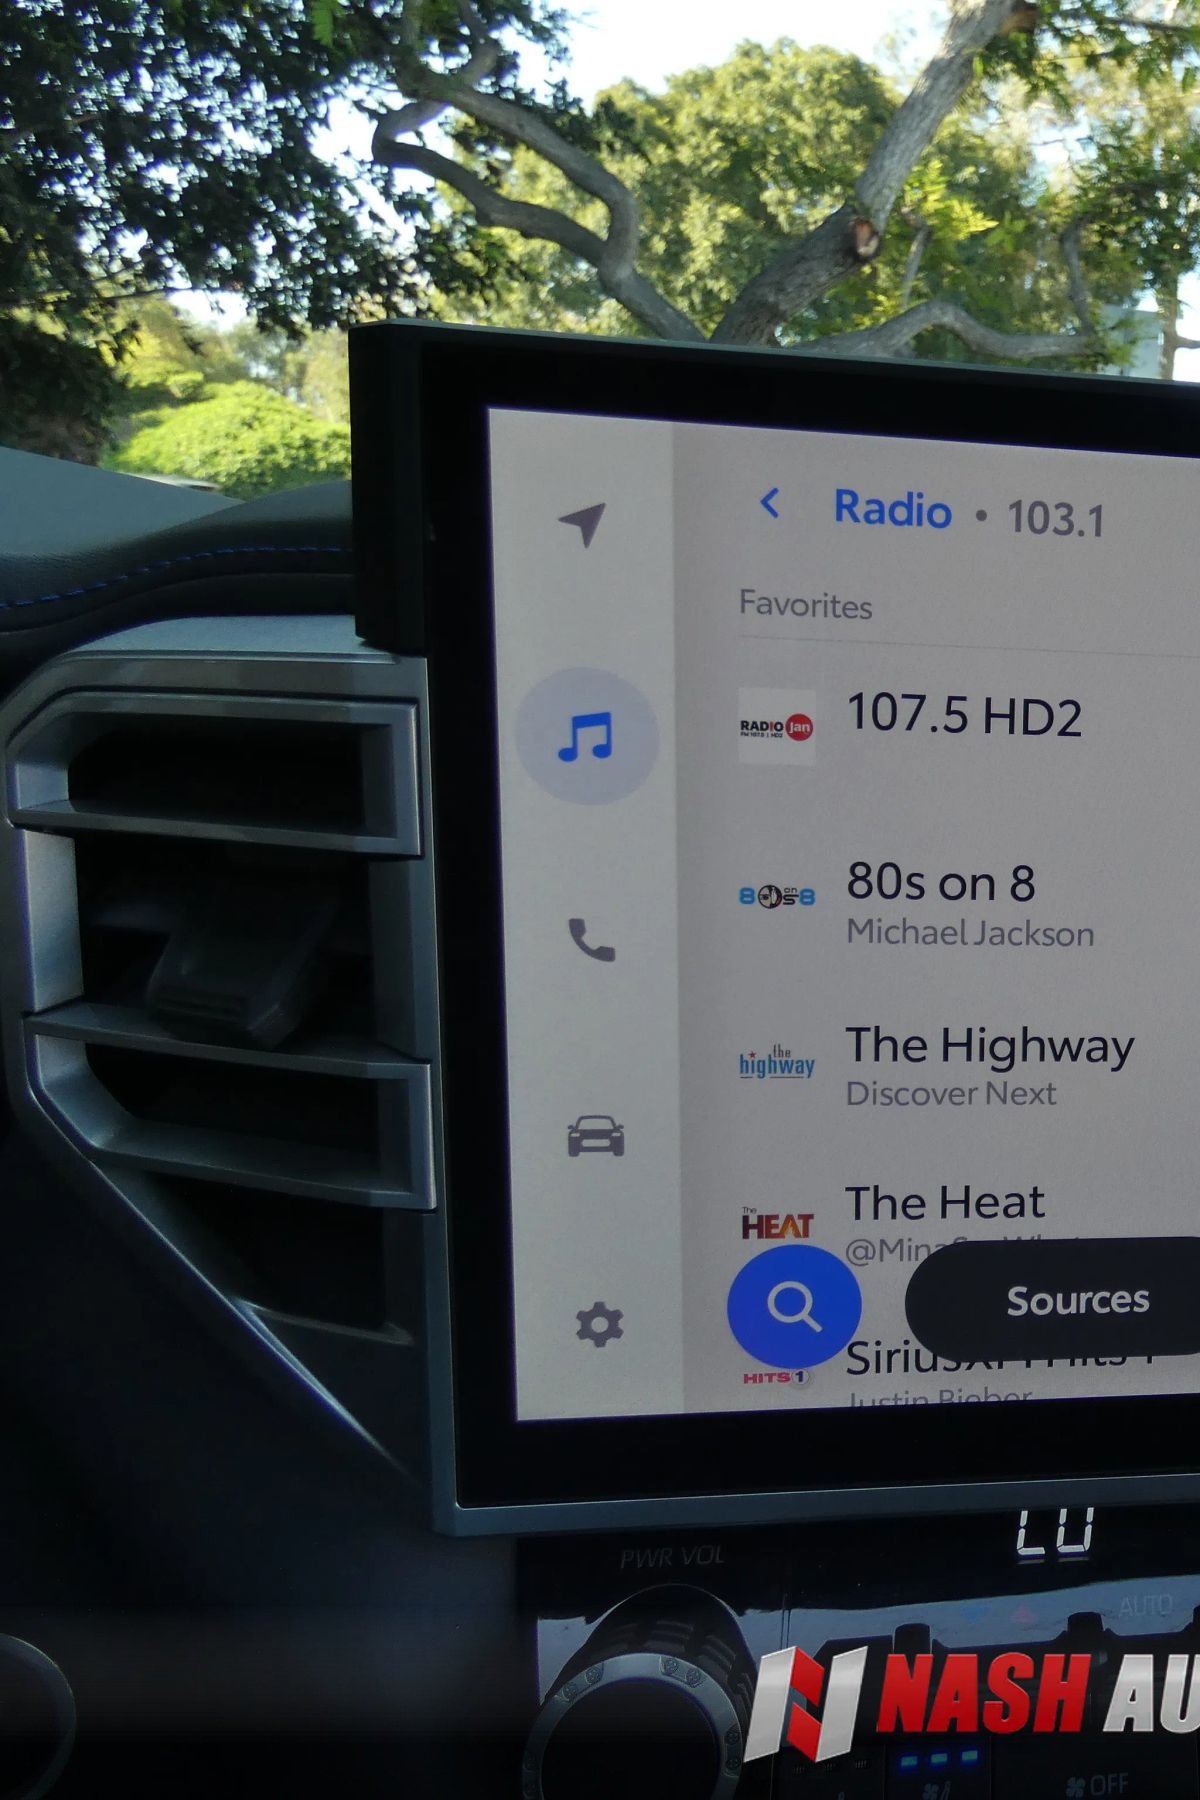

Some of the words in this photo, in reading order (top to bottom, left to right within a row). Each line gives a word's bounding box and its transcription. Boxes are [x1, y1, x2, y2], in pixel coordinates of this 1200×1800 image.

[835, 488, 952, 530] Radio
[1007, 499, 1104, 538] 103.1
[739, 588, 873, 620] Favorites
[740, 720, 784, 732] RADIO
[848, 691, 970, 734] 107.5
[983, 697, 1084, 737] HD2
[847, 861, 926, 900] 80s
[938, 872, 996, 901] on
[1010, 865, 1036, 903] 8
[847, 917, 968, 946] Michael
[974, 921, 1095, 948] Jackson
[773, 1043, 792, 1058] the
[845, 1026, 928, 1063] The
[941, 1026, 1136, 1074] Highway
[740, 1053, 815, 1080] highway
[847, 1081, 979, 1107] Discover
[986, 1081, 1058, 1107] Next
[845, 1184, 927, 1222] The
[940, 1184, 1046, 1220] Heat
[742, 1213, 815, 1240] HEAT
[1006, 1285, 1151, 1317] Sources
[743, 1371, 792, 1385] HITS
[620, 1547, 674, 1570] PWR
[681, 1543, 726, 1566] VOL
[1117, 1593, 1174, 1617] AUTO
[1090, 1771, 1130, 1797] OFF
